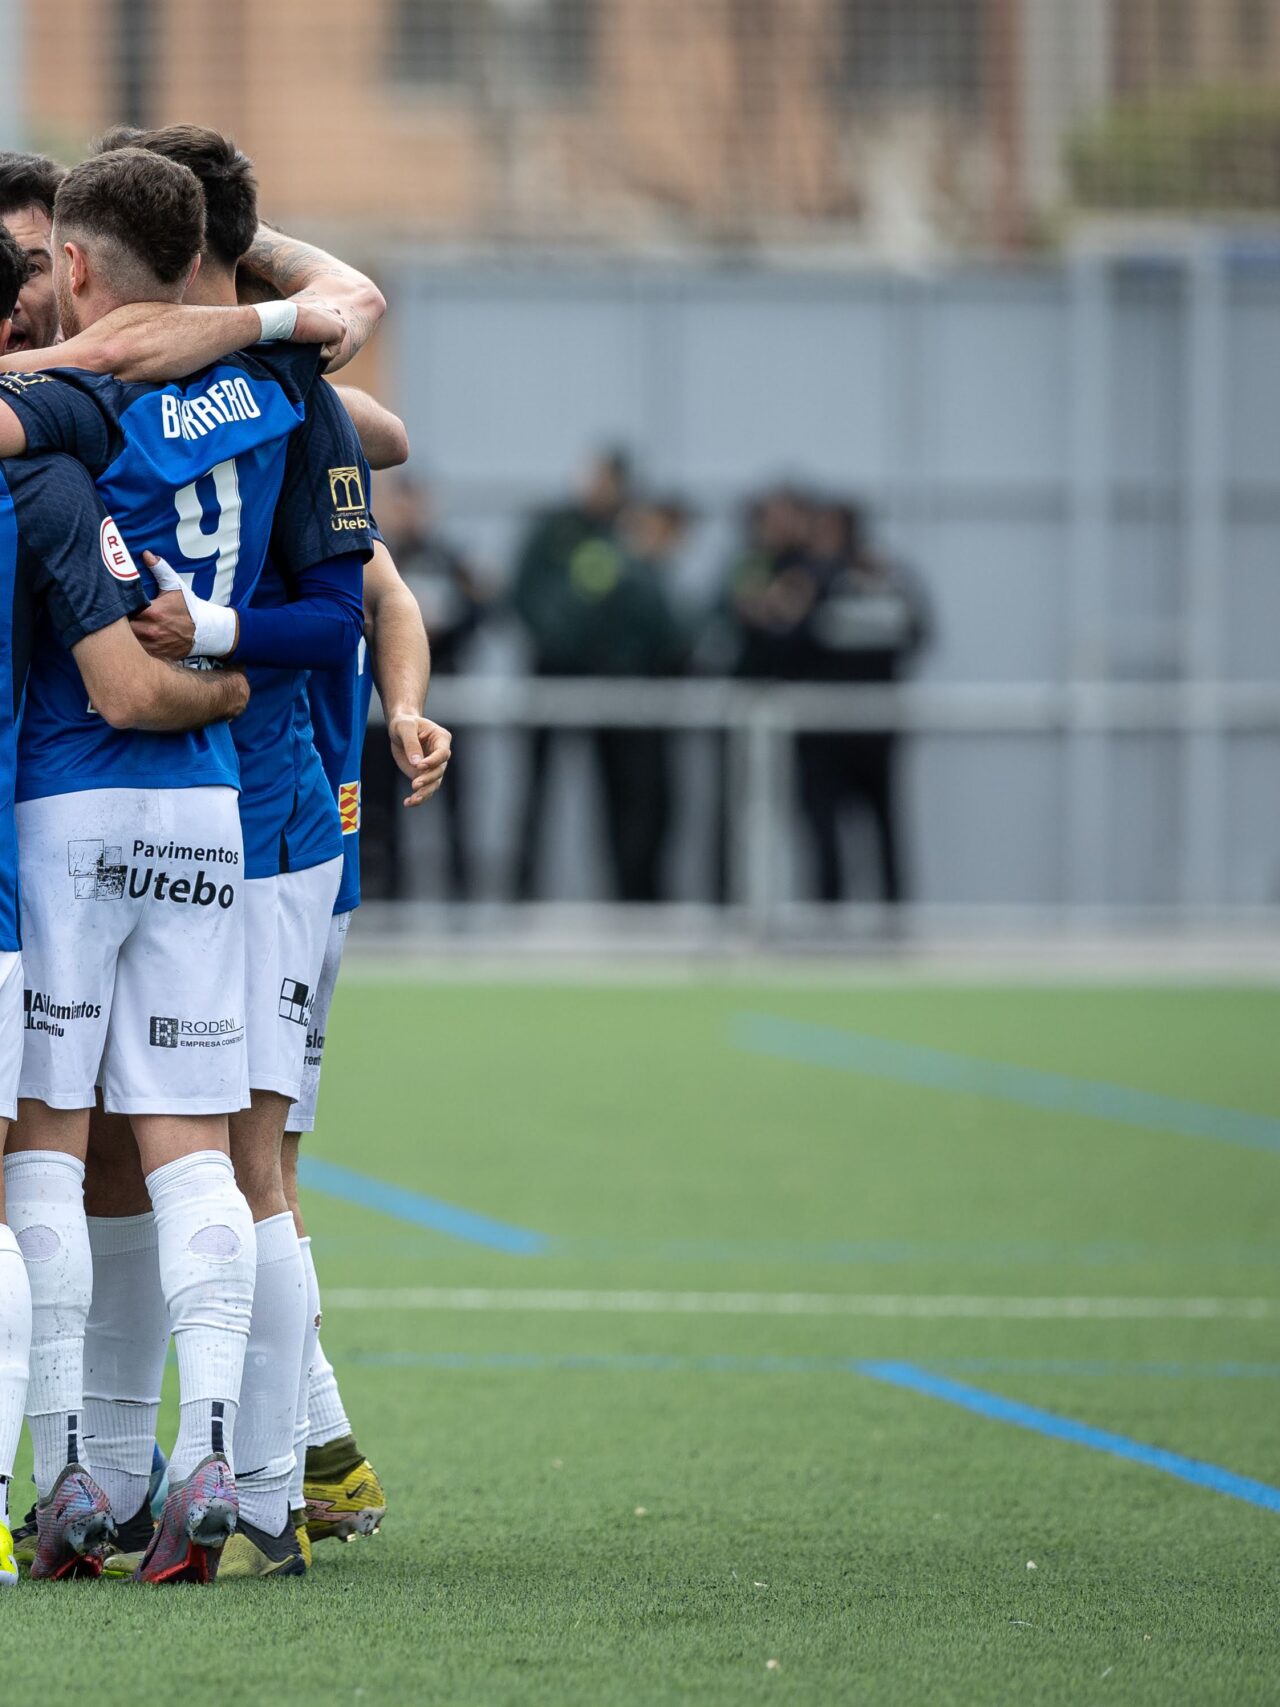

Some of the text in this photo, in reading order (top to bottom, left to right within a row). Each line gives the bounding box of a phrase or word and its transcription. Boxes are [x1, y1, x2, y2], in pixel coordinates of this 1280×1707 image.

[174, 458, 242, 607] 9
[133, 840, 239, 865] Pavimentos
[128, 867, 235, 909] Utebo
[180, 1040, 221, 1048] EMPRESA
